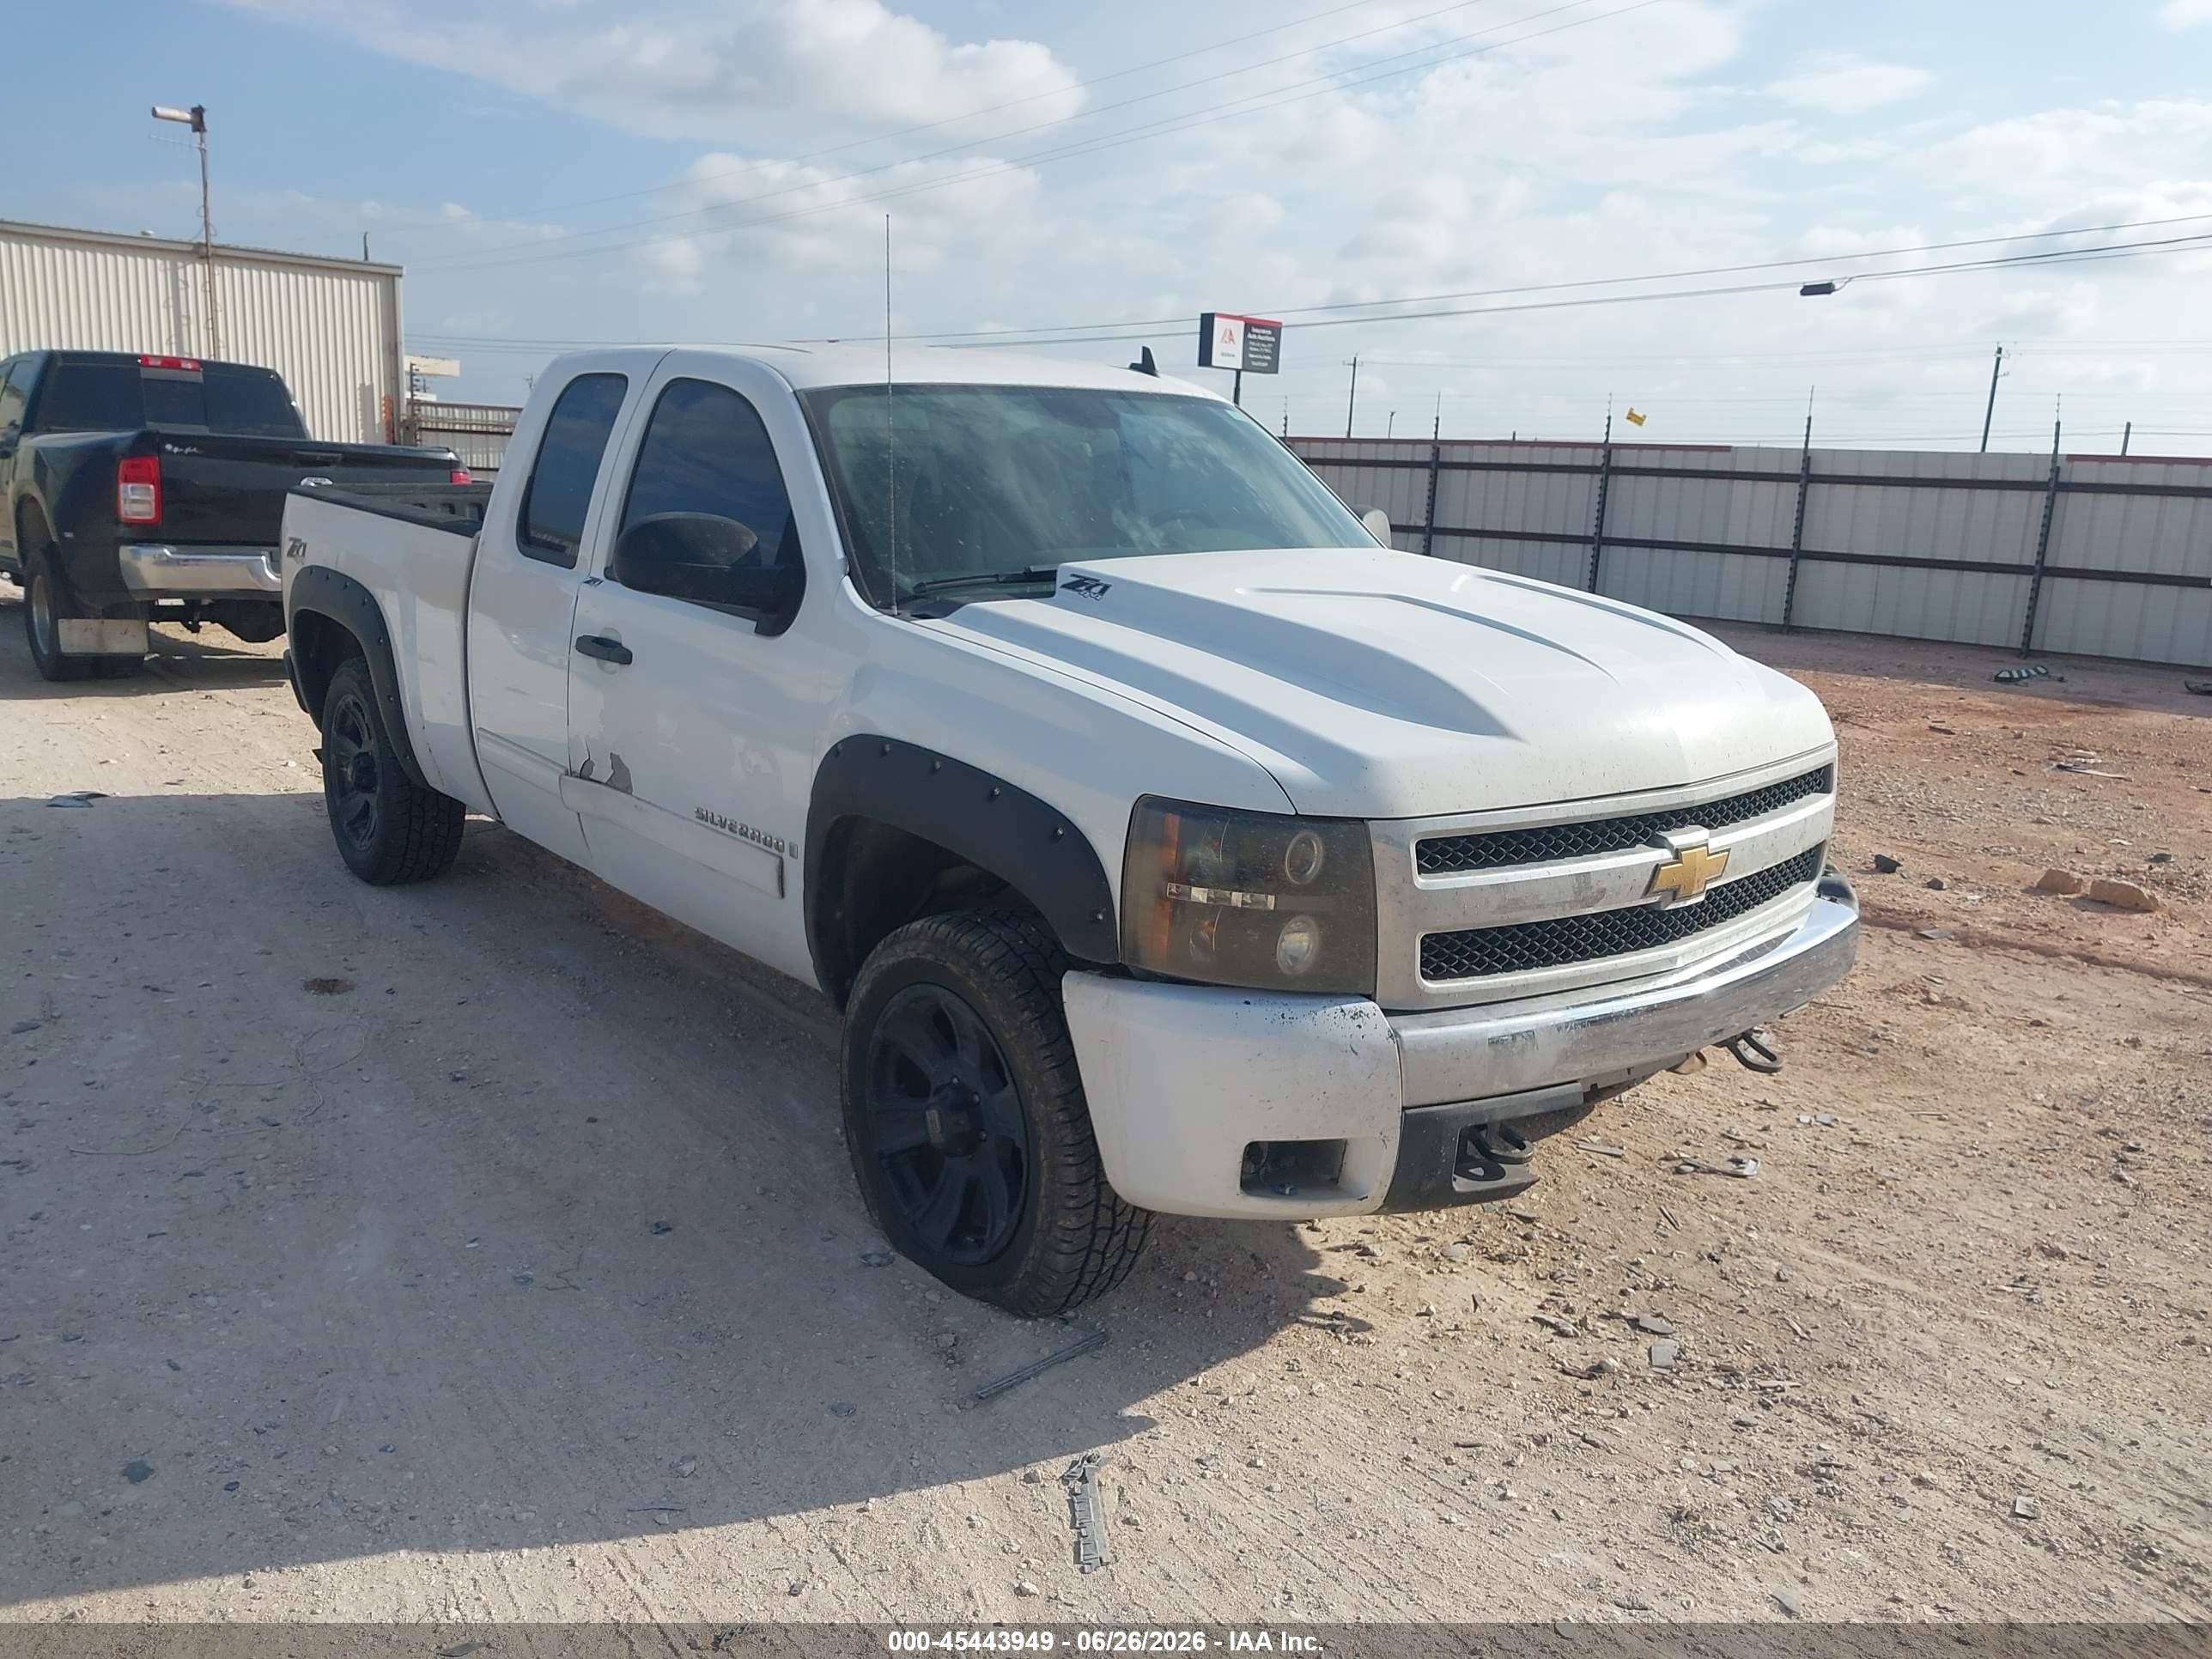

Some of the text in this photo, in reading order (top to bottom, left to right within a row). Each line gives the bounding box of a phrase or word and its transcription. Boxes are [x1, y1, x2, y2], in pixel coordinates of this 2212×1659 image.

[286, 536, 307, 558] Z71
[1060, 574, 1112, 596] Z71
[695, 806, 785, 853] SILVERADO
